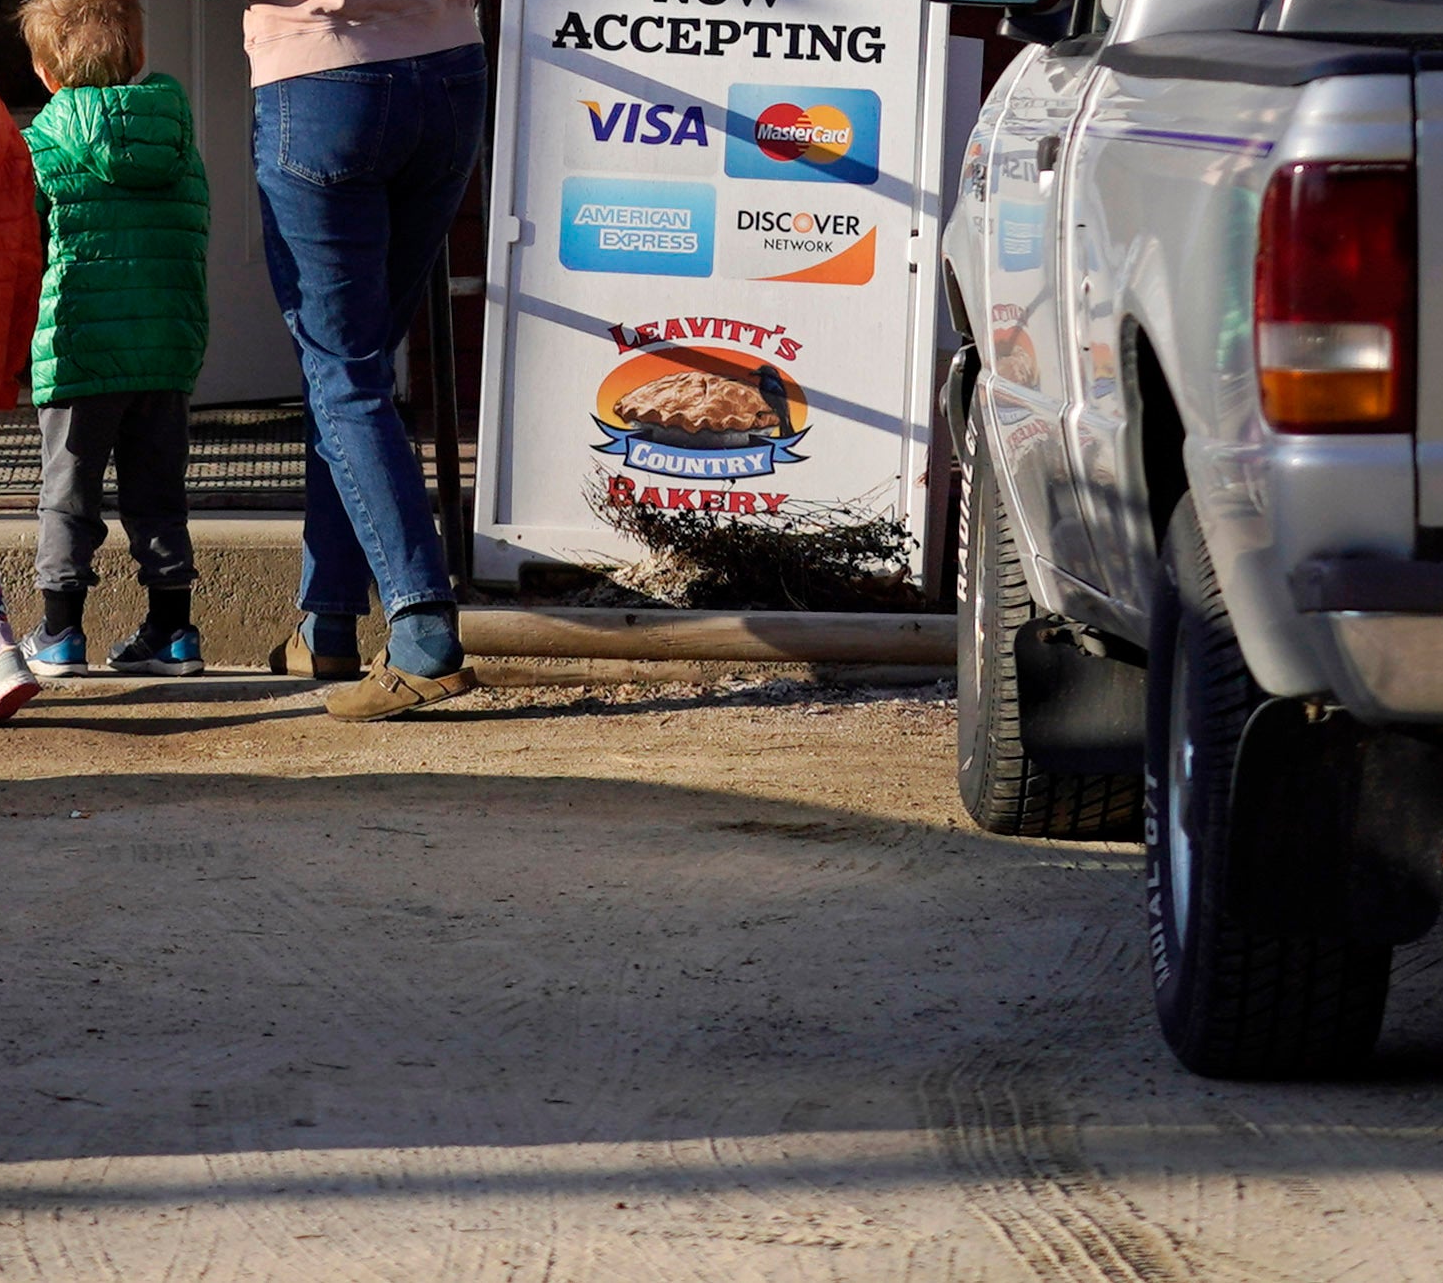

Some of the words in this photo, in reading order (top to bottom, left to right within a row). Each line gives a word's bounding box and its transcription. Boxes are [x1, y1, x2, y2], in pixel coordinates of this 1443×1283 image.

[552, 11, 886, 64] ACCEPTING
[577, 99, 710, 147] VISA
[756, 123, 853, 146] MasterCard
[573, 203, 691, 230] AMERICAN
[737, 209, 860, 237] DISCOVER
[599, 228, 699, 253] EXPRESS
[764, 238, 834, 254] NETWORK
[608, 316, 803, 362] LEAVITT'S
[630, 442, 768, 476] COUNTRY
[607, 475, 791, 517] BAKERY
[956, 461, 976, 603] RADIAL
